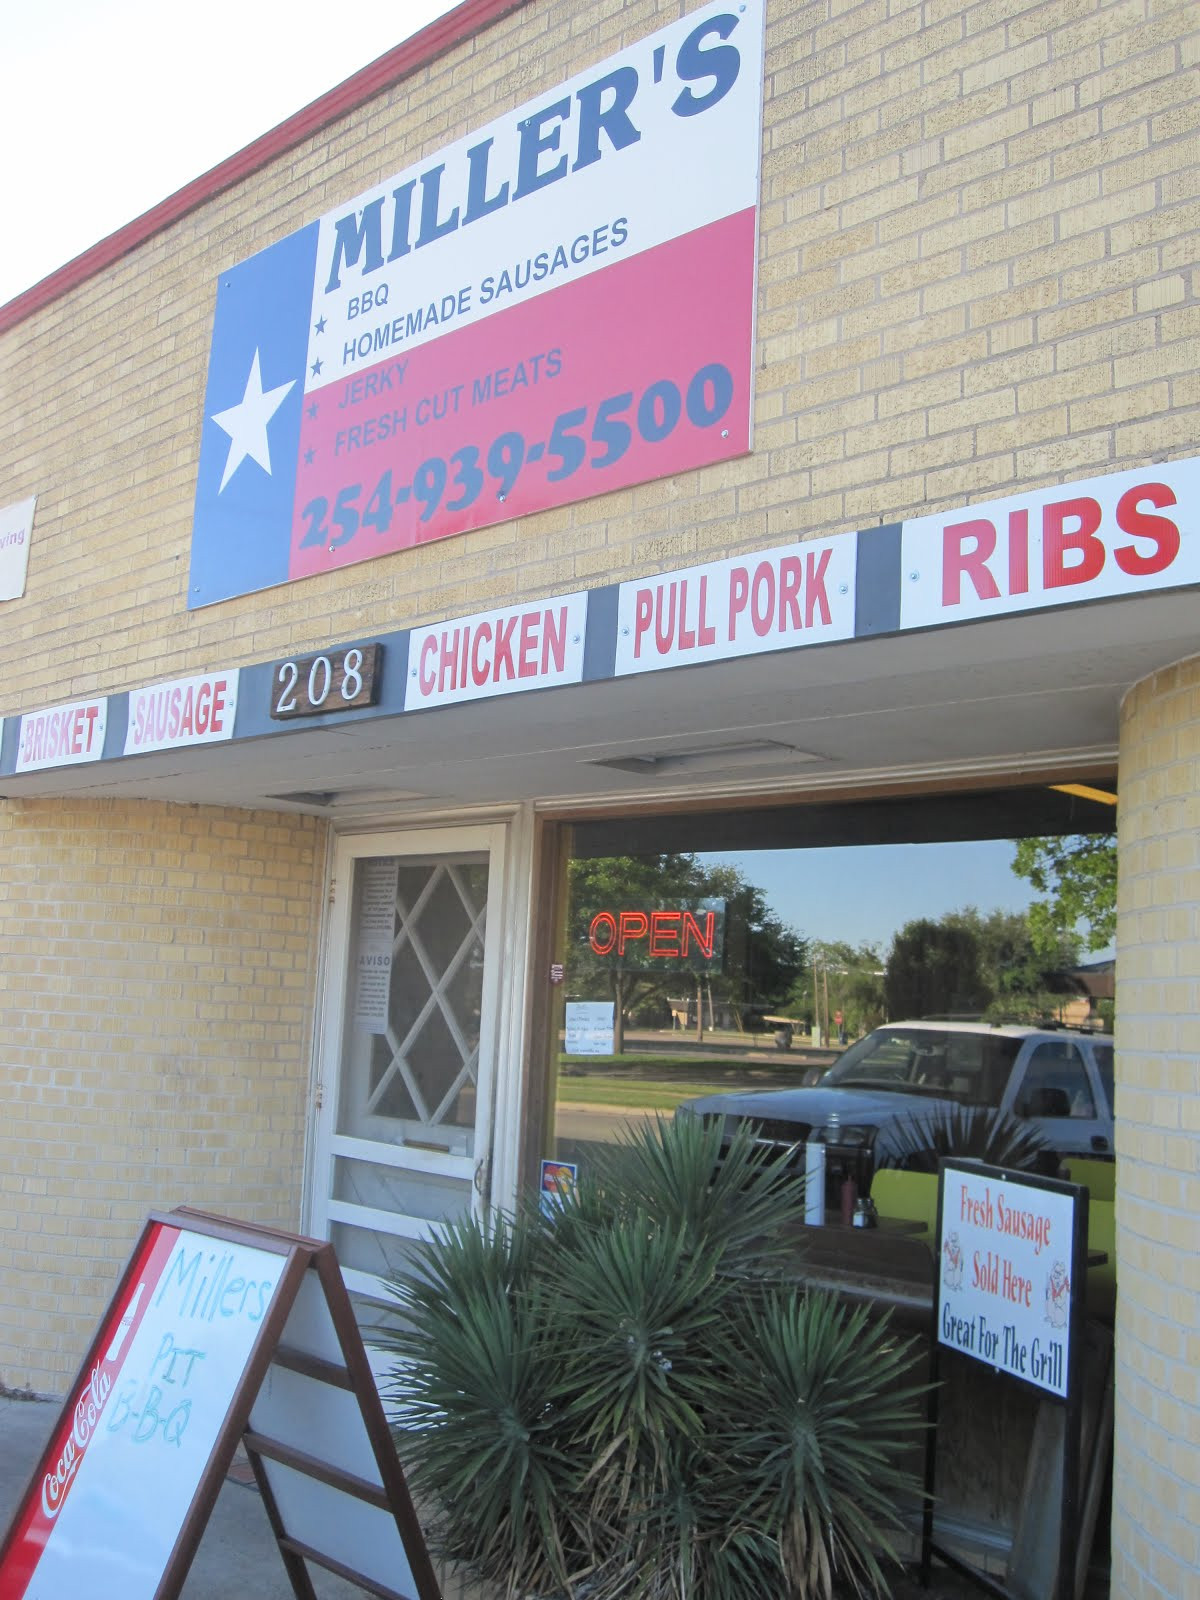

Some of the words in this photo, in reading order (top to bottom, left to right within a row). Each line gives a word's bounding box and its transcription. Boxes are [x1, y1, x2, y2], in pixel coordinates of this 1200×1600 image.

[324, 13, 741, 294] MILLER'S
[342, 287, 472, 366] HOMEMADE
[479, 216, 629, 306] SAUSAGES
[347, 283, 389, 321] BBQ
[334, 409, 407, 457] FRESH
[415, 386, 463, 426] CUT
[471, 348, 563, 407] MEATS
[338, 359, 409, 409] JERKY
[299, 363, 734, 550] 254-939-5500
[942, 482, 1181, 607] RIBS
[634, 575, 716, 658] PULL
[728, 547, 833, 642] PORK
[275, 647, 363, 713] 208
[418, 605, 568, 697] CHICKEN
[23, 706, 98, 764] BRISKET
[134, 679, 227, 745] SAUSAGE
[360, 955, 391, 966] AVISO
[589, 911, 715, 958] OPEN
[960, 1184, 993, 1229] Fresh
[997, 1194, 1051, 1256] Sausage
[155, 1247, 272, 1323] Millers
[972, 1250, 999, 1296] Sold
[1003, 1258, 1032, 1308] Here
[150, 1332, 207, 1388] PIT
[943, 1302, 976, 1347] Great
[979, 1315, 999, 1360] For
[1003, 1325, 1027, 1374] The
[1031, 1337, 1063, 1389] Grill
